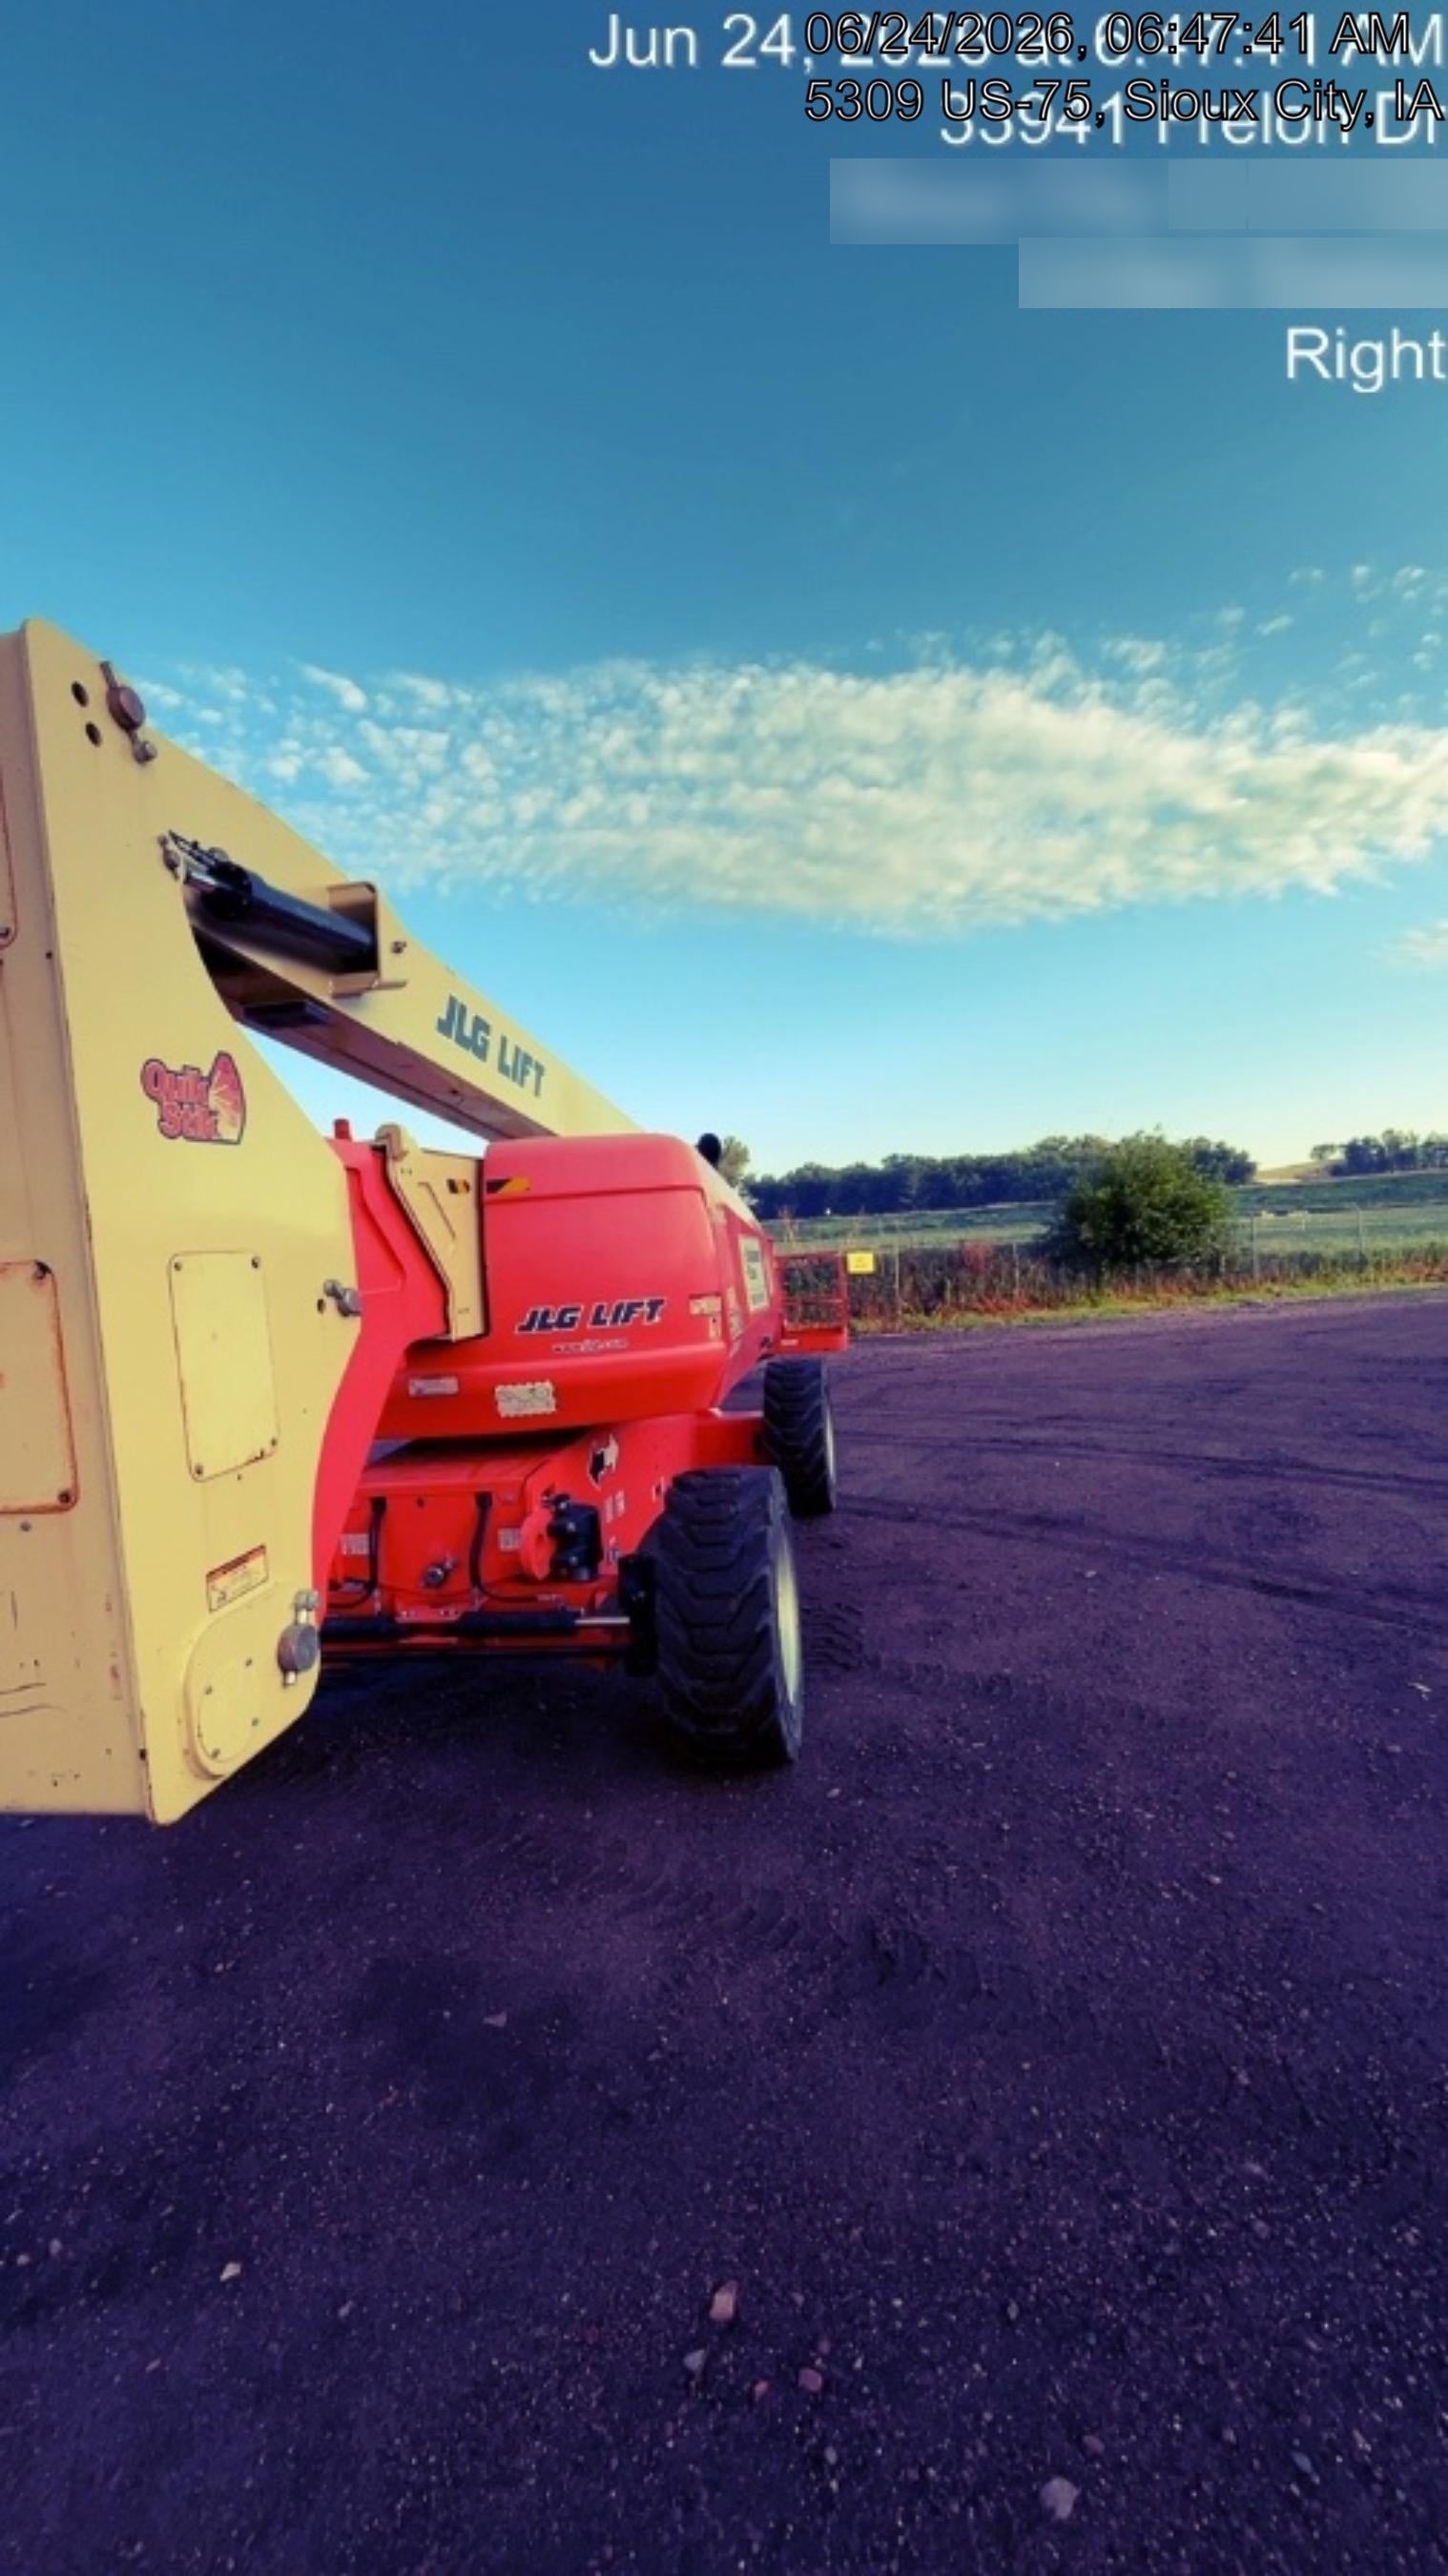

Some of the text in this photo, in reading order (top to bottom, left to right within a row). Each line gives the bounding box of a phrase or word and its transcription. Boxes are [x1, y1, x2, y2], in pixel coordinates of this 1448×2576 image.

[436, 993, 545, 1096] JLG LIFT
[517, 1306, 582, 1333] JLG
[589, 1298, 666, 1327] LIFT
